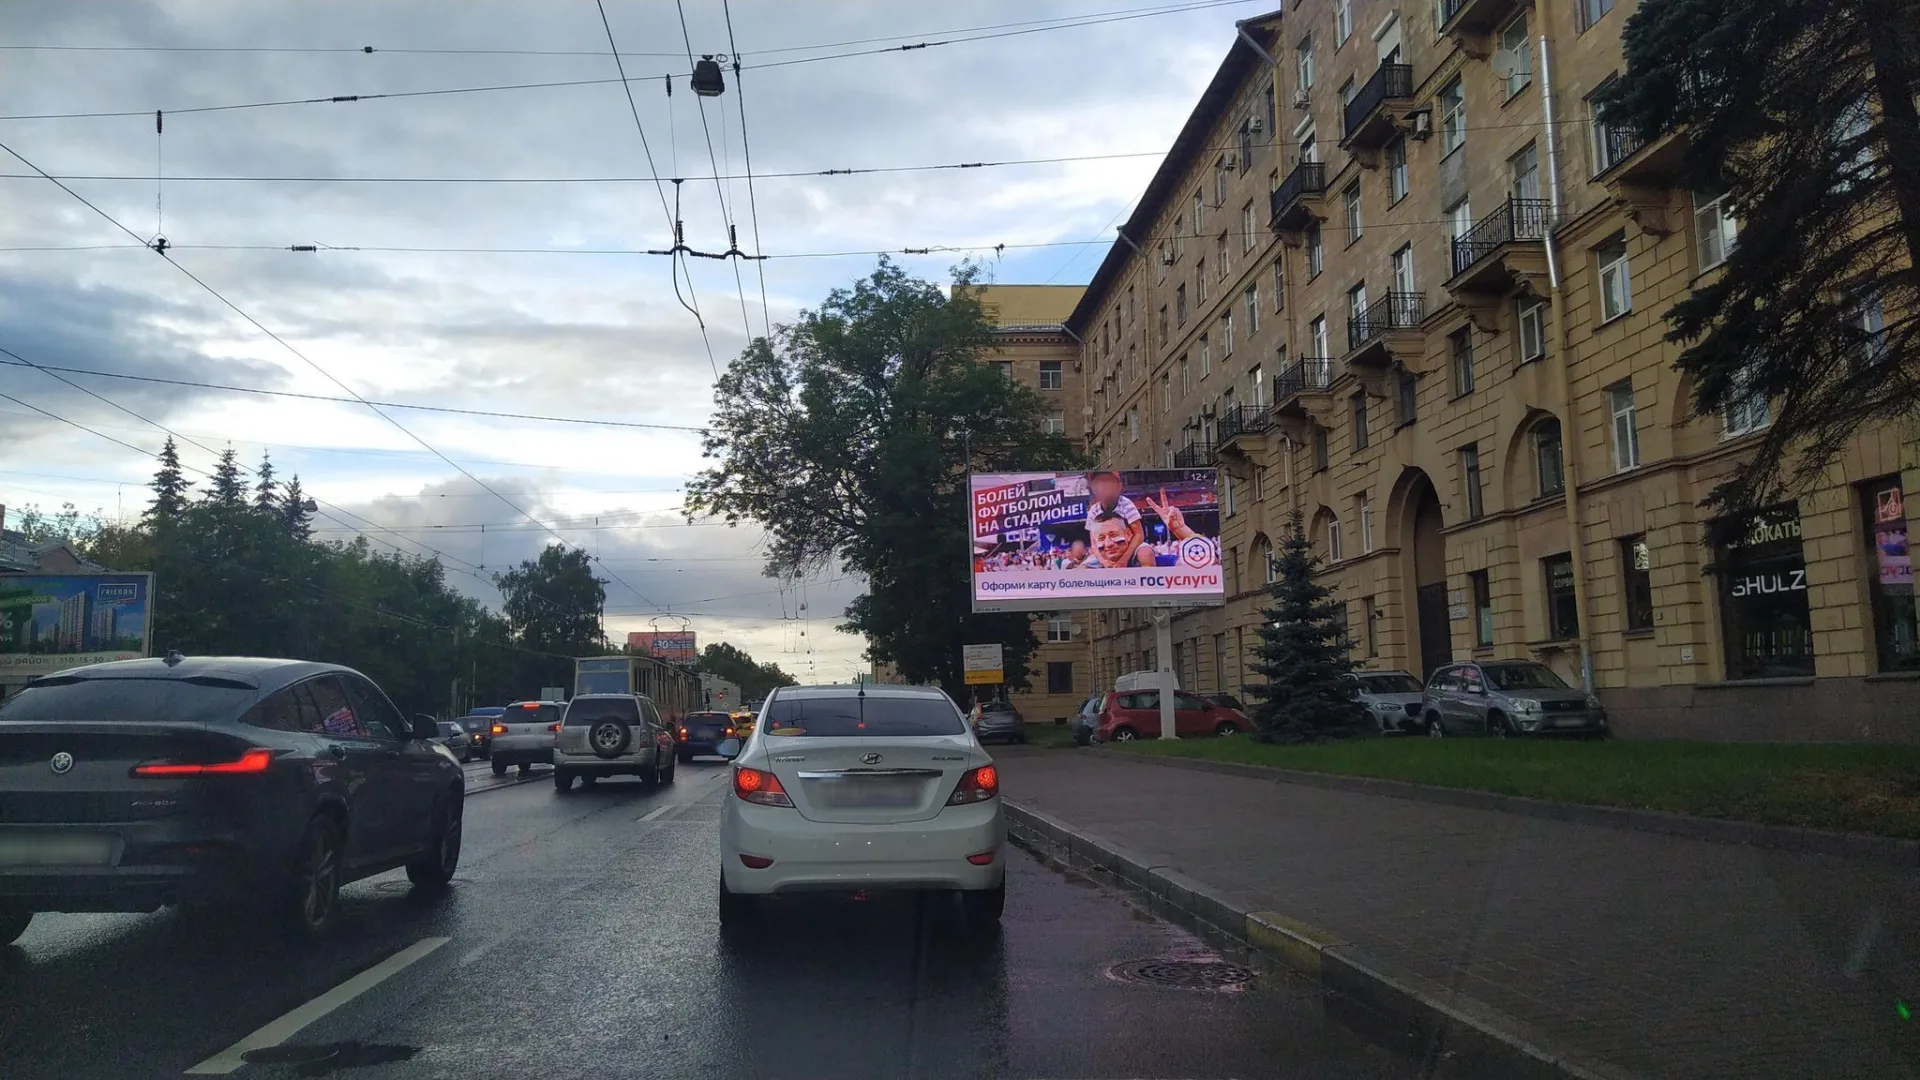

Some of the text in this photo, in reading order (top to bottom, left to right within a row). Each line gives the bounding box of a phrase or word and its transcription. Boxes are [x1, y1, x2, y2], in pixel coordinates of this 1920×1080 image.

[1190, 472, 1207, 481] 12+
[977, 484, 1026, 505] БОЛЕЙ
[978, 493, 1061, 518] ФУТБОЛОМ
[979, 503, 1084, 534] НА СТАДИОНЕ!
[981, 575, 1217, 592] Оформи карту болельщика на госуслуги
[1732, 569, 1806, 597] SHULZ
